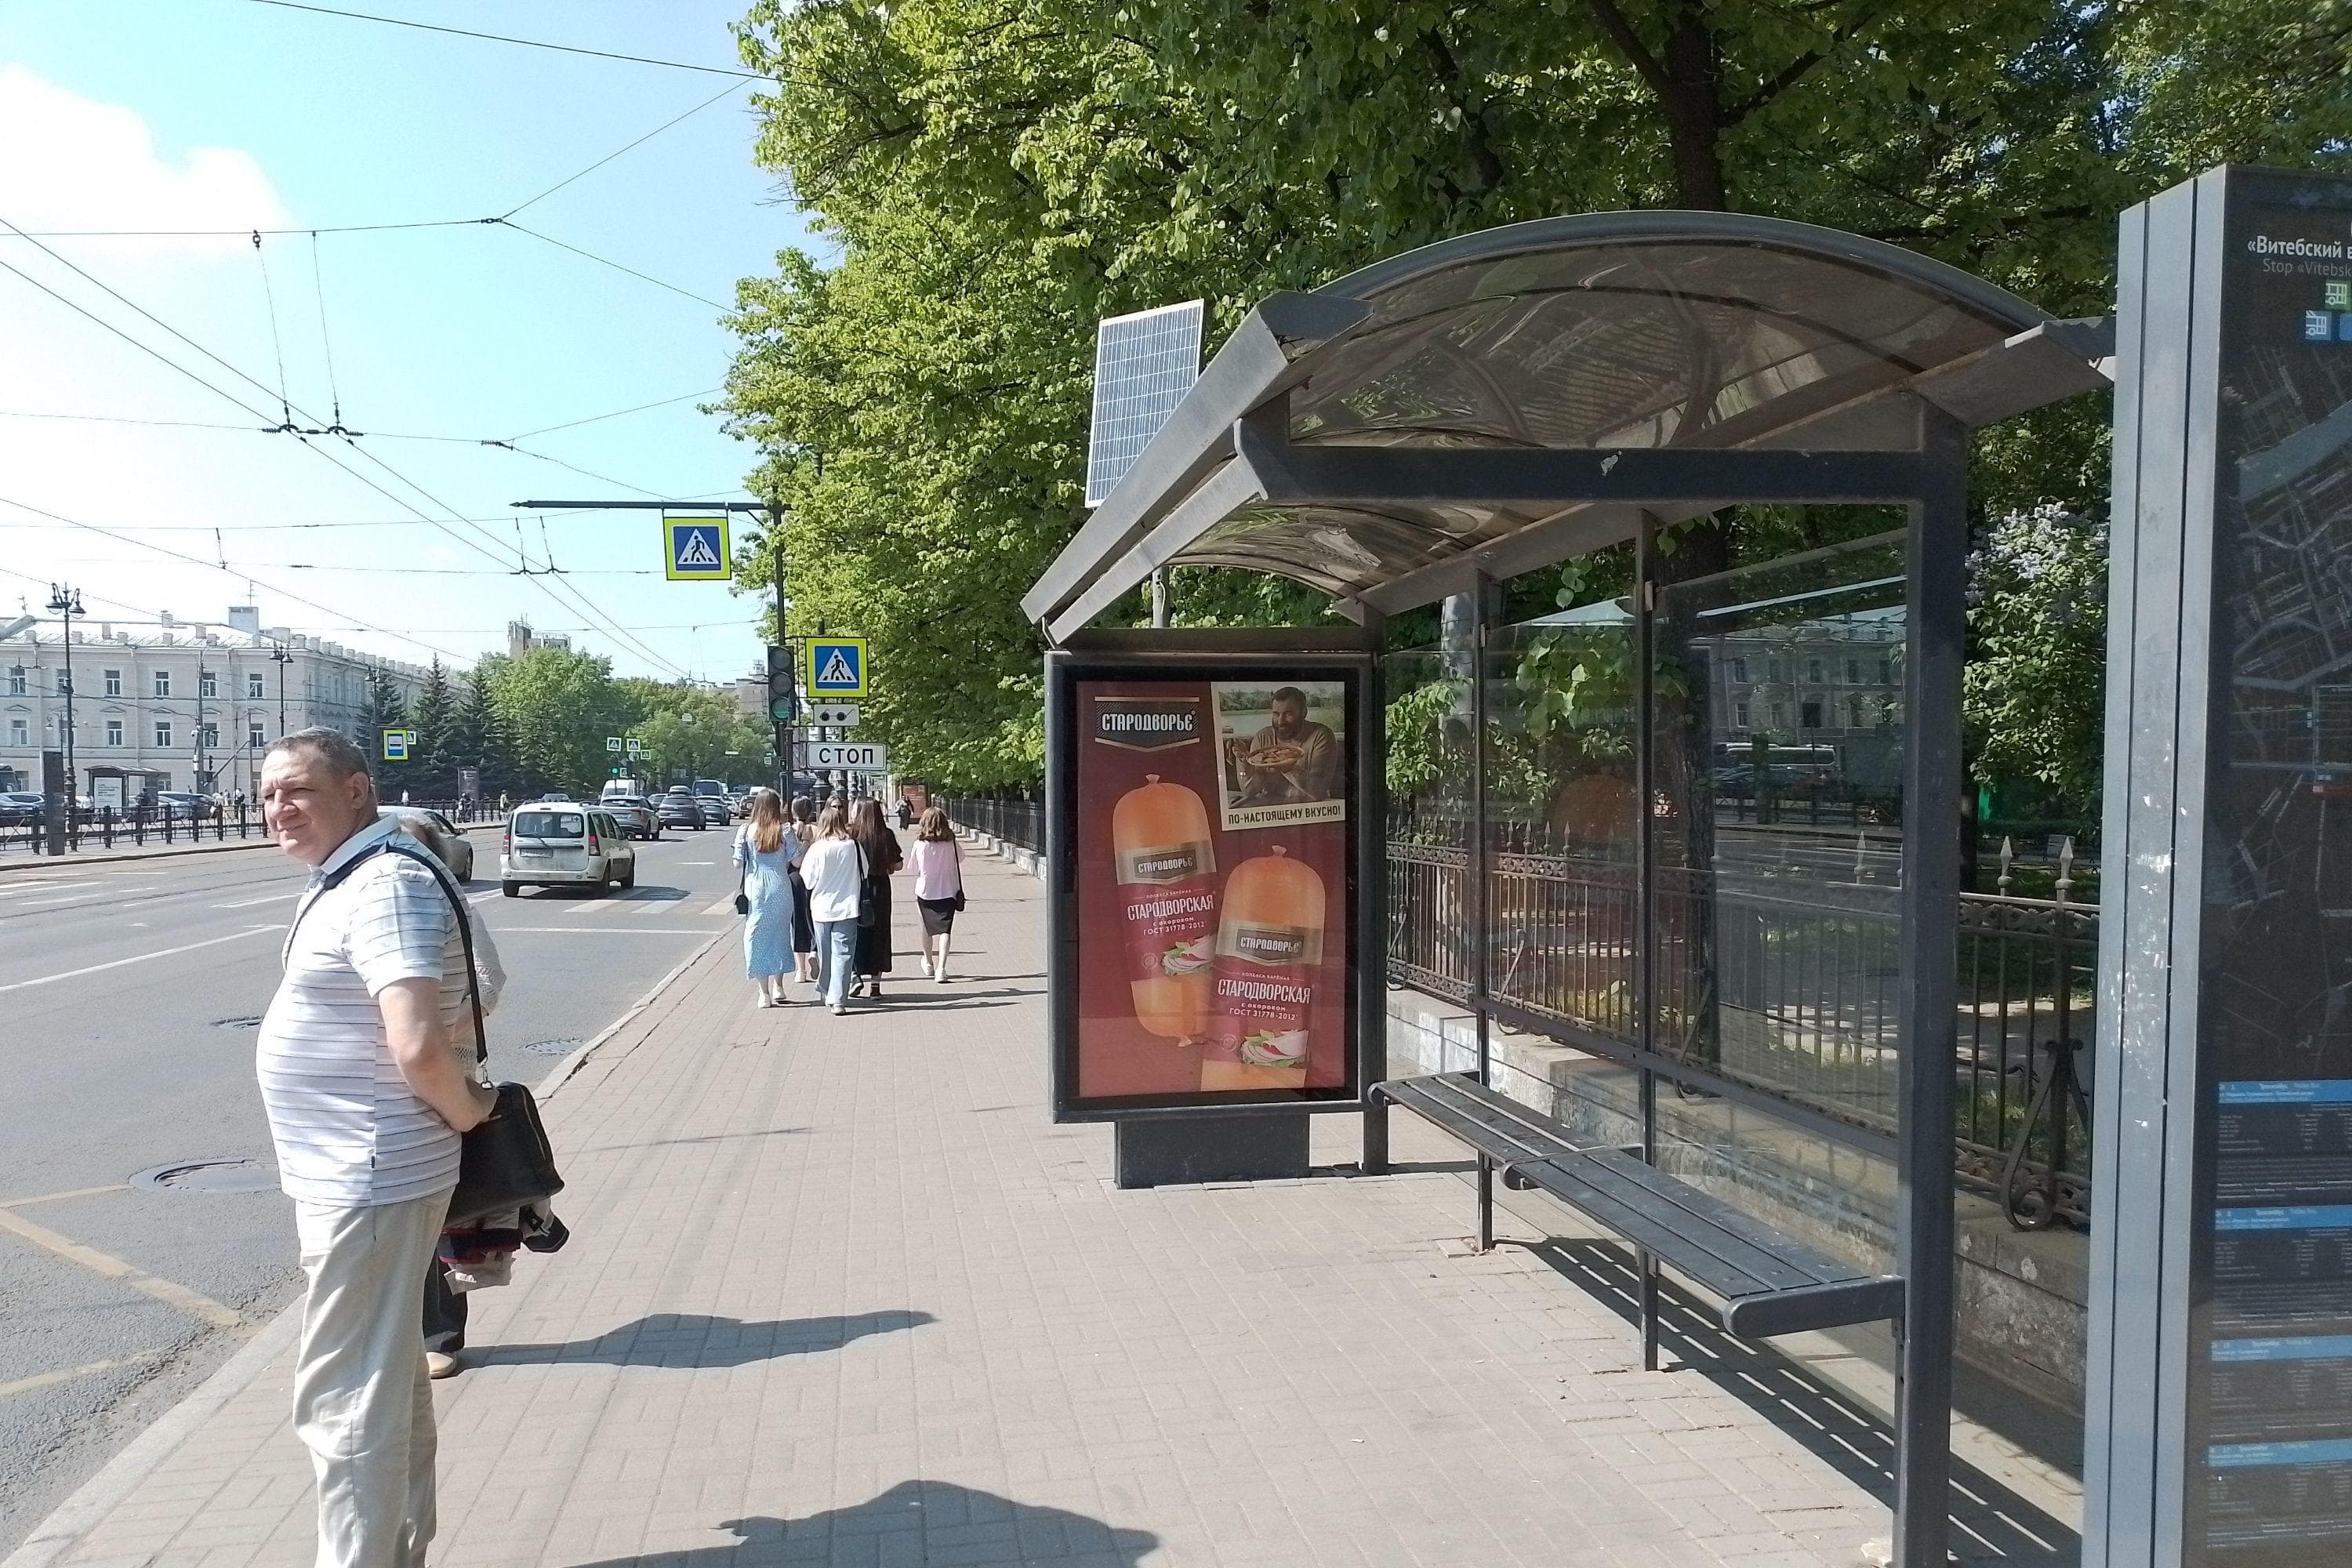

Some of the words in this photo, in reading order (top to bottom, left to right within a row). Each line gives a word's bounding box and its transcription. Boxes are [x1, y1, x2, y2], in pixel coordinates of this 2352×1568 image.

[2247, 234, 2342, 259] «Витебский
[2263, 258, 2293, 276] Stop
[818, 747, 873, 764] СТОП
[1228, 808, 1303, 825] ПО-НАСТОЯЩЕМУ
[1305, 805, 1341, 818] ВКУСНО!
[1127, 895, 1214, 921] СТАРОДВОРСКАЯ
[1159, 916, 1194, 926] окороком
[1143, 927, 1163, 935] ГОСТ
[1218, 978, 1311, 1004] СТАРОДВОРСКАЯ
[1229, 1007, 1251, 1016] ГОСТ
[1247, 1003, 1286, 1011] окороком
